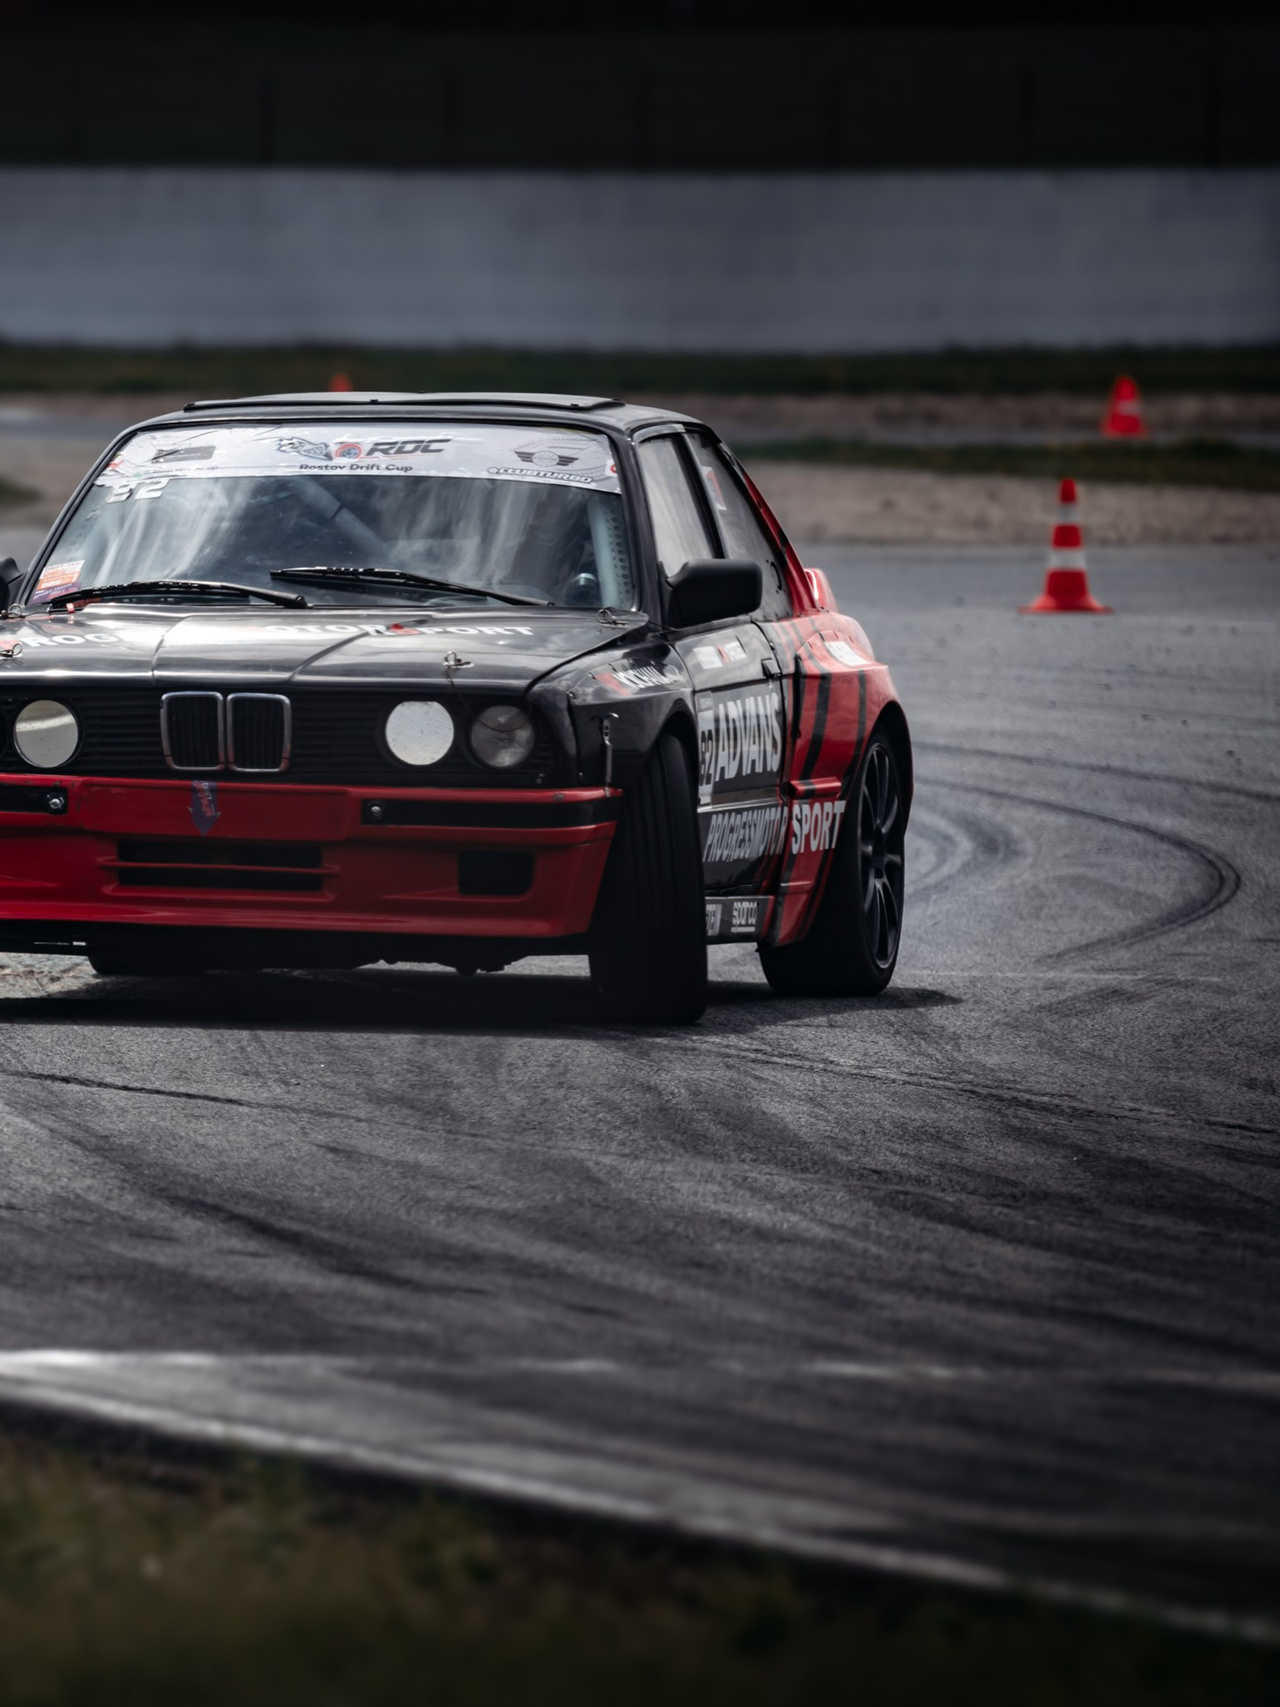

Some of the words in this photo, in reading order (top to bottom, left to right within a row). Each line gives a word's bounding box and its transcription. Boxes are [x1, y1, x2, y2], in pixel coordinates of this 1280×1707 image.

[365, 438, 452, 456] RDC
[299, 463, 346, 471] Rostov
[349, 463, 381, 471] Drift
[385, 464, 413, 473] Cup
[715, 692, 782, 782] ADVANS
[791, 800, 846, 855] SPORT
